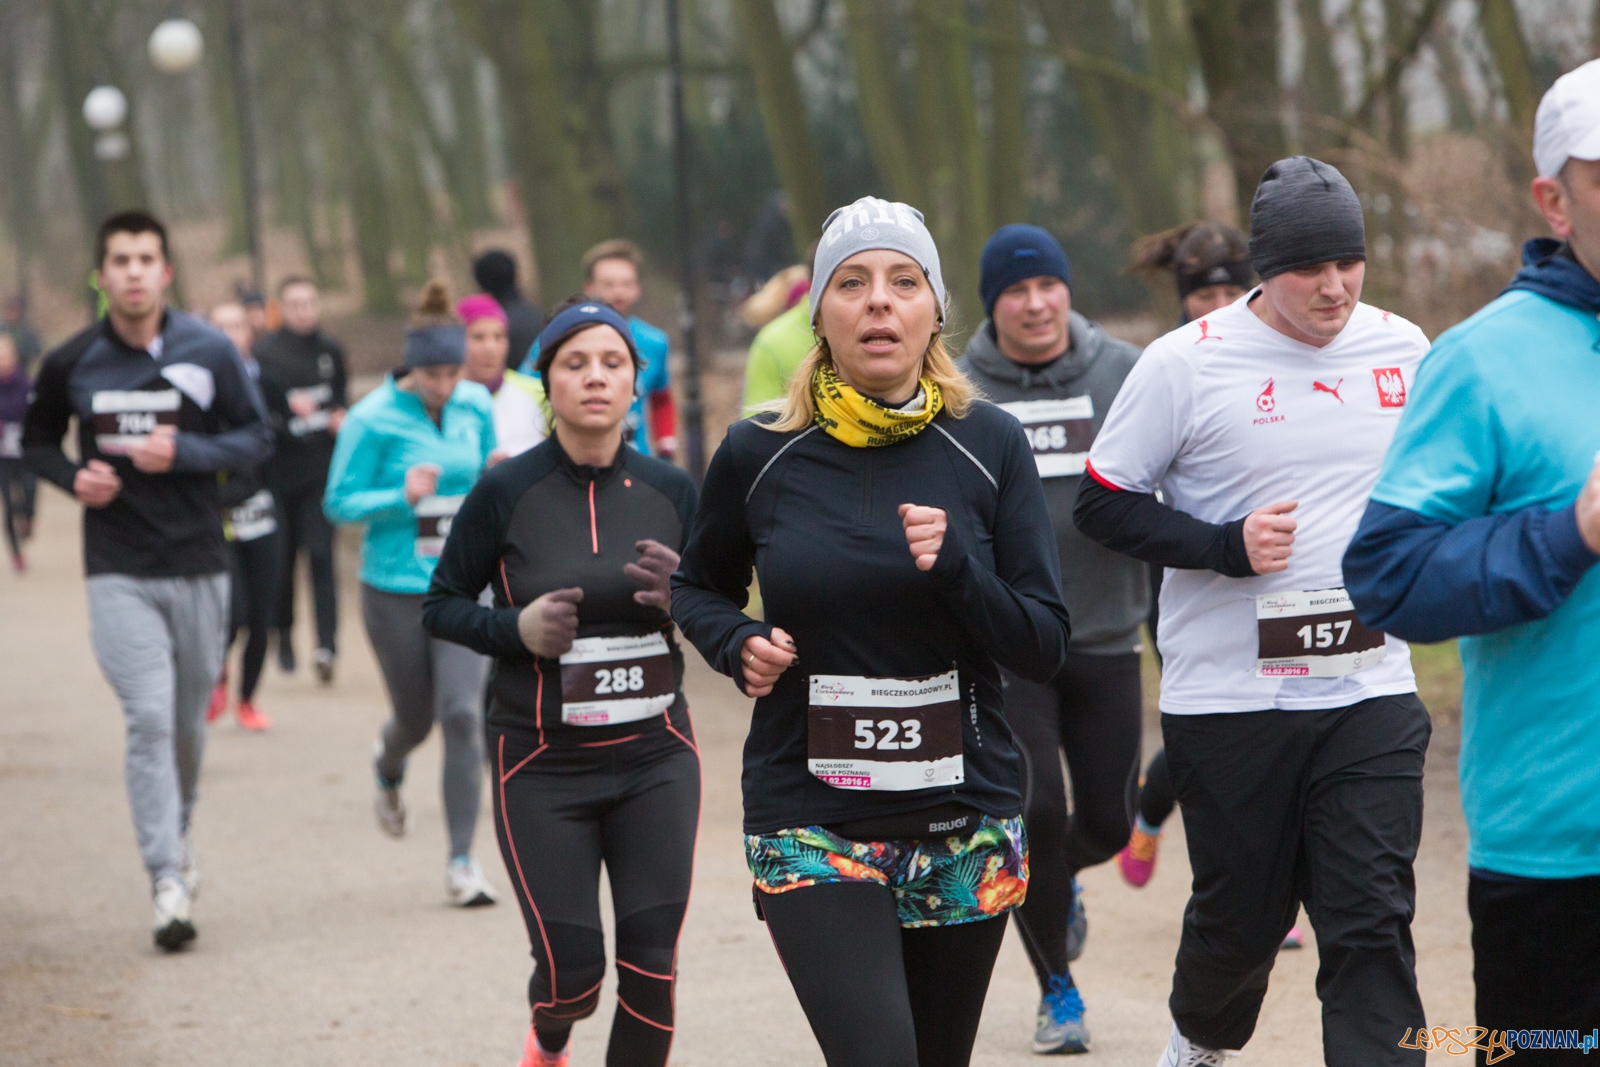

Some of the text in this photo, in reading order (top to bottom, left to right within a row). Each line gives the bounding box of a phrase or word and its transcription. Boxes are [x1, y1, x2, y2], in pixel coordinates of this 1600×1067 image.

[1253, 415, 1286, 425] POLSKA
[1296, 619, 1353, 649] 157
[594, 665, 645, 695] 288
[871, 683, 953, 697] BIEGCZEKOLADOWY.PL
[854, 718, 923, 750] 523
[928, 817, 968, 832] BRUGI
